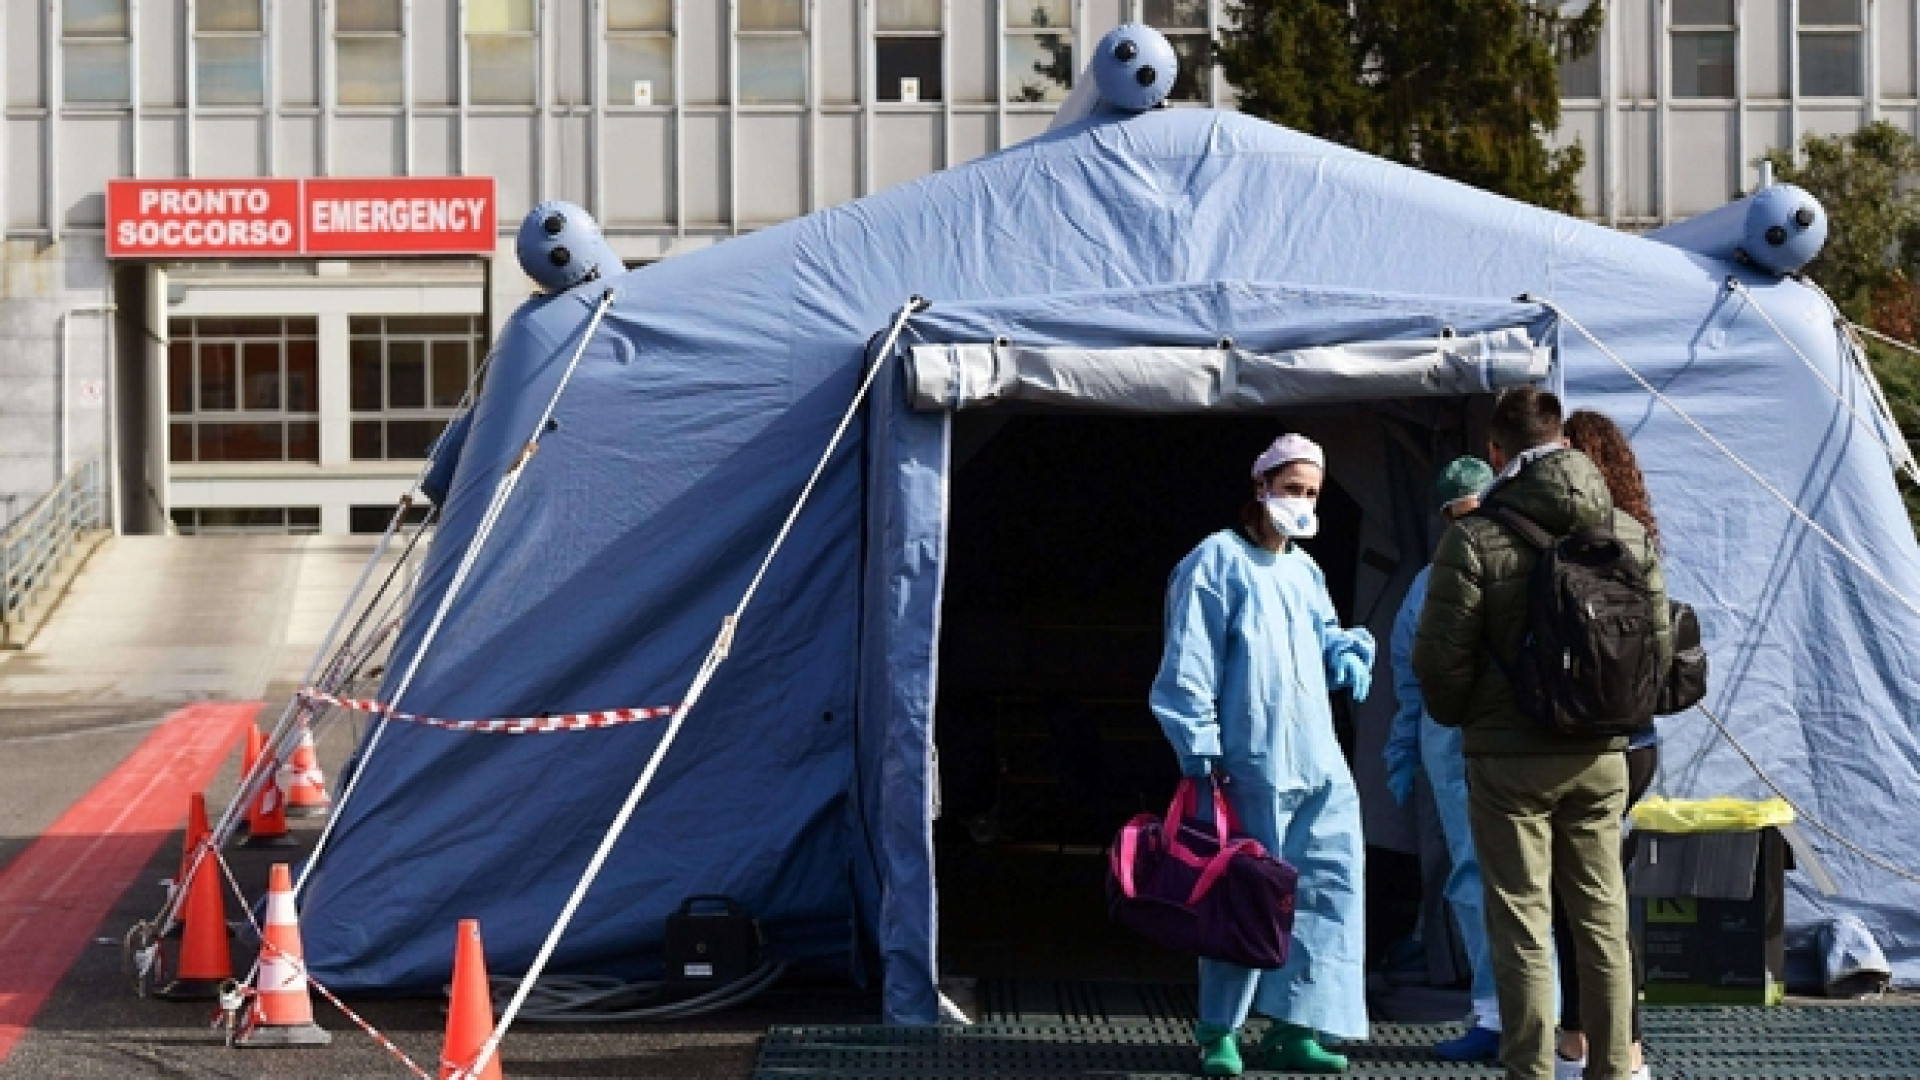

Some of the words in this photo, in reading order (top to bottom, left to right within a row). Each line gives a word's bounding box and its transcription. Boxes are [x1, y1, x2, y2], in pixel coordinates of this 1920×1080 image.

[139, 188, 270, 214] PRONTO
[312, 197, 487, 233] EMERGENCY
[116, 219, 292, 246] SOCCORSO
